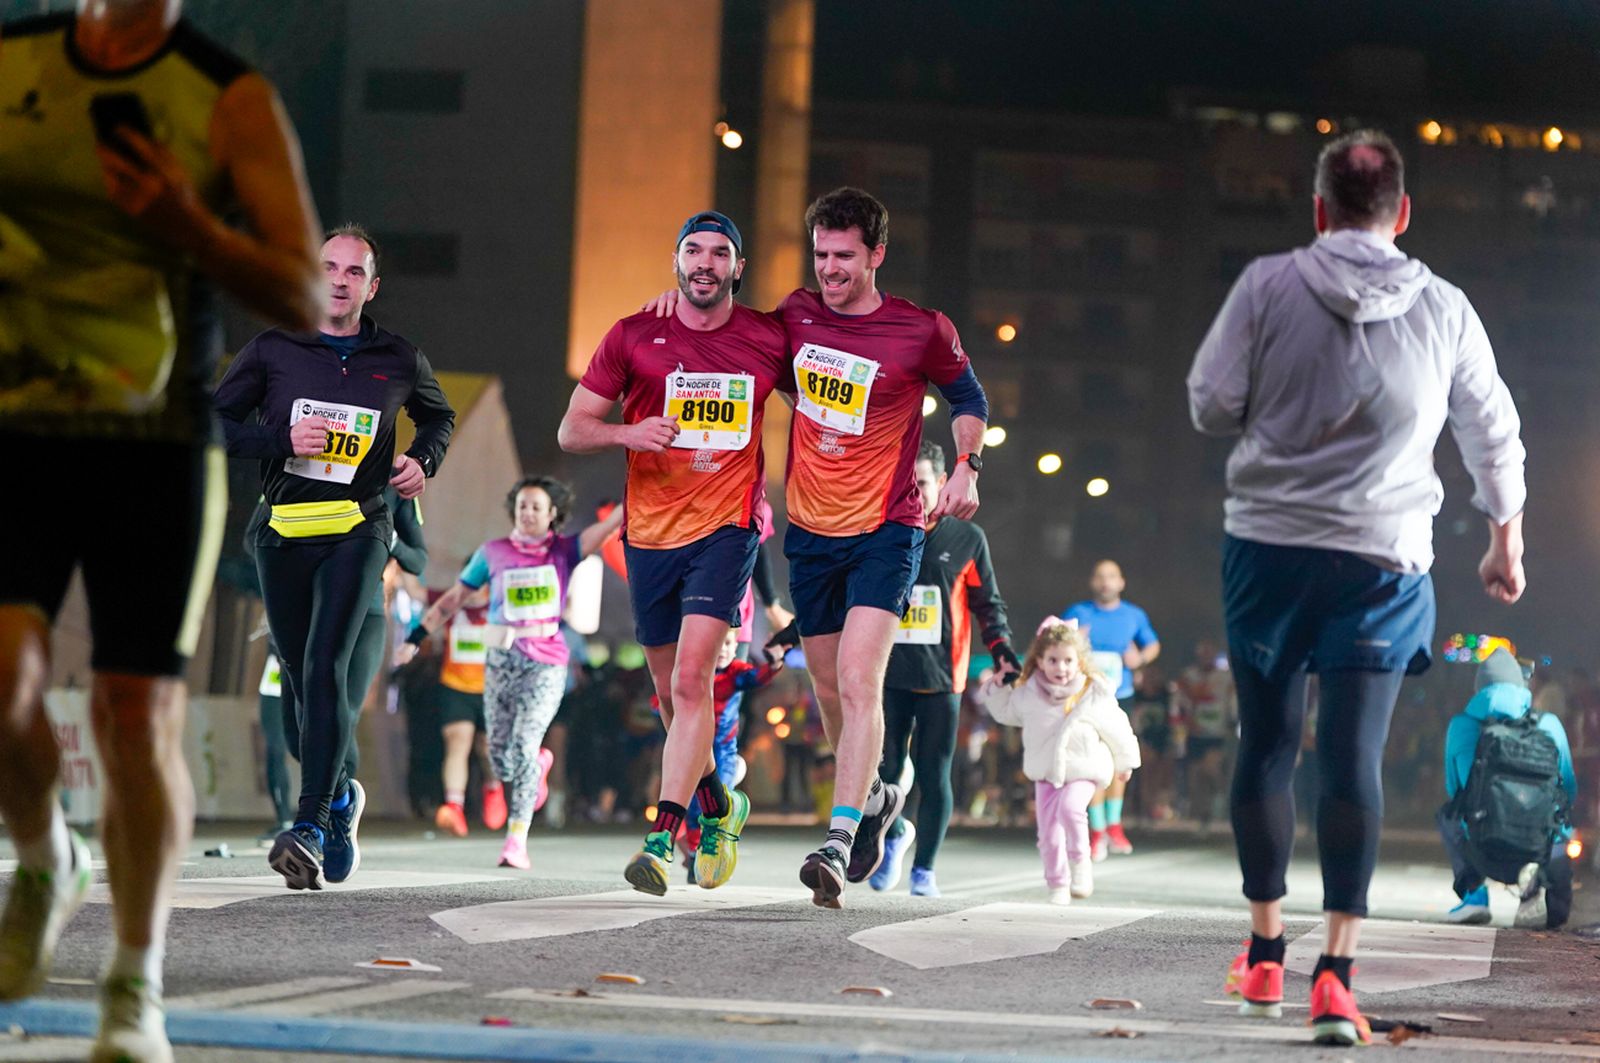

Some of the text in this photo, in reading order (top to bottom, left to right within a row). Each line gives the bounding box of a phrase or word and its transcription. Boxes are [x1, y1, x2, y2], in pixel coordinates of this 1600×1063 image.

[802, 360, 817, 370] SAN
[815, 355, 837, 366] NOCHE
[836, 359, 846, 369] DE
[686, 381, 710, 389] NOCHE
[711, 381, 721, 389] DE
[807, 372, 854, 405] 8189
[676, 390, 692, 399] SAN
[312, 409, 337, 420] NOCHE
[338, 412, 349, 421] DE
[682, 400, 735, 423] 8190
